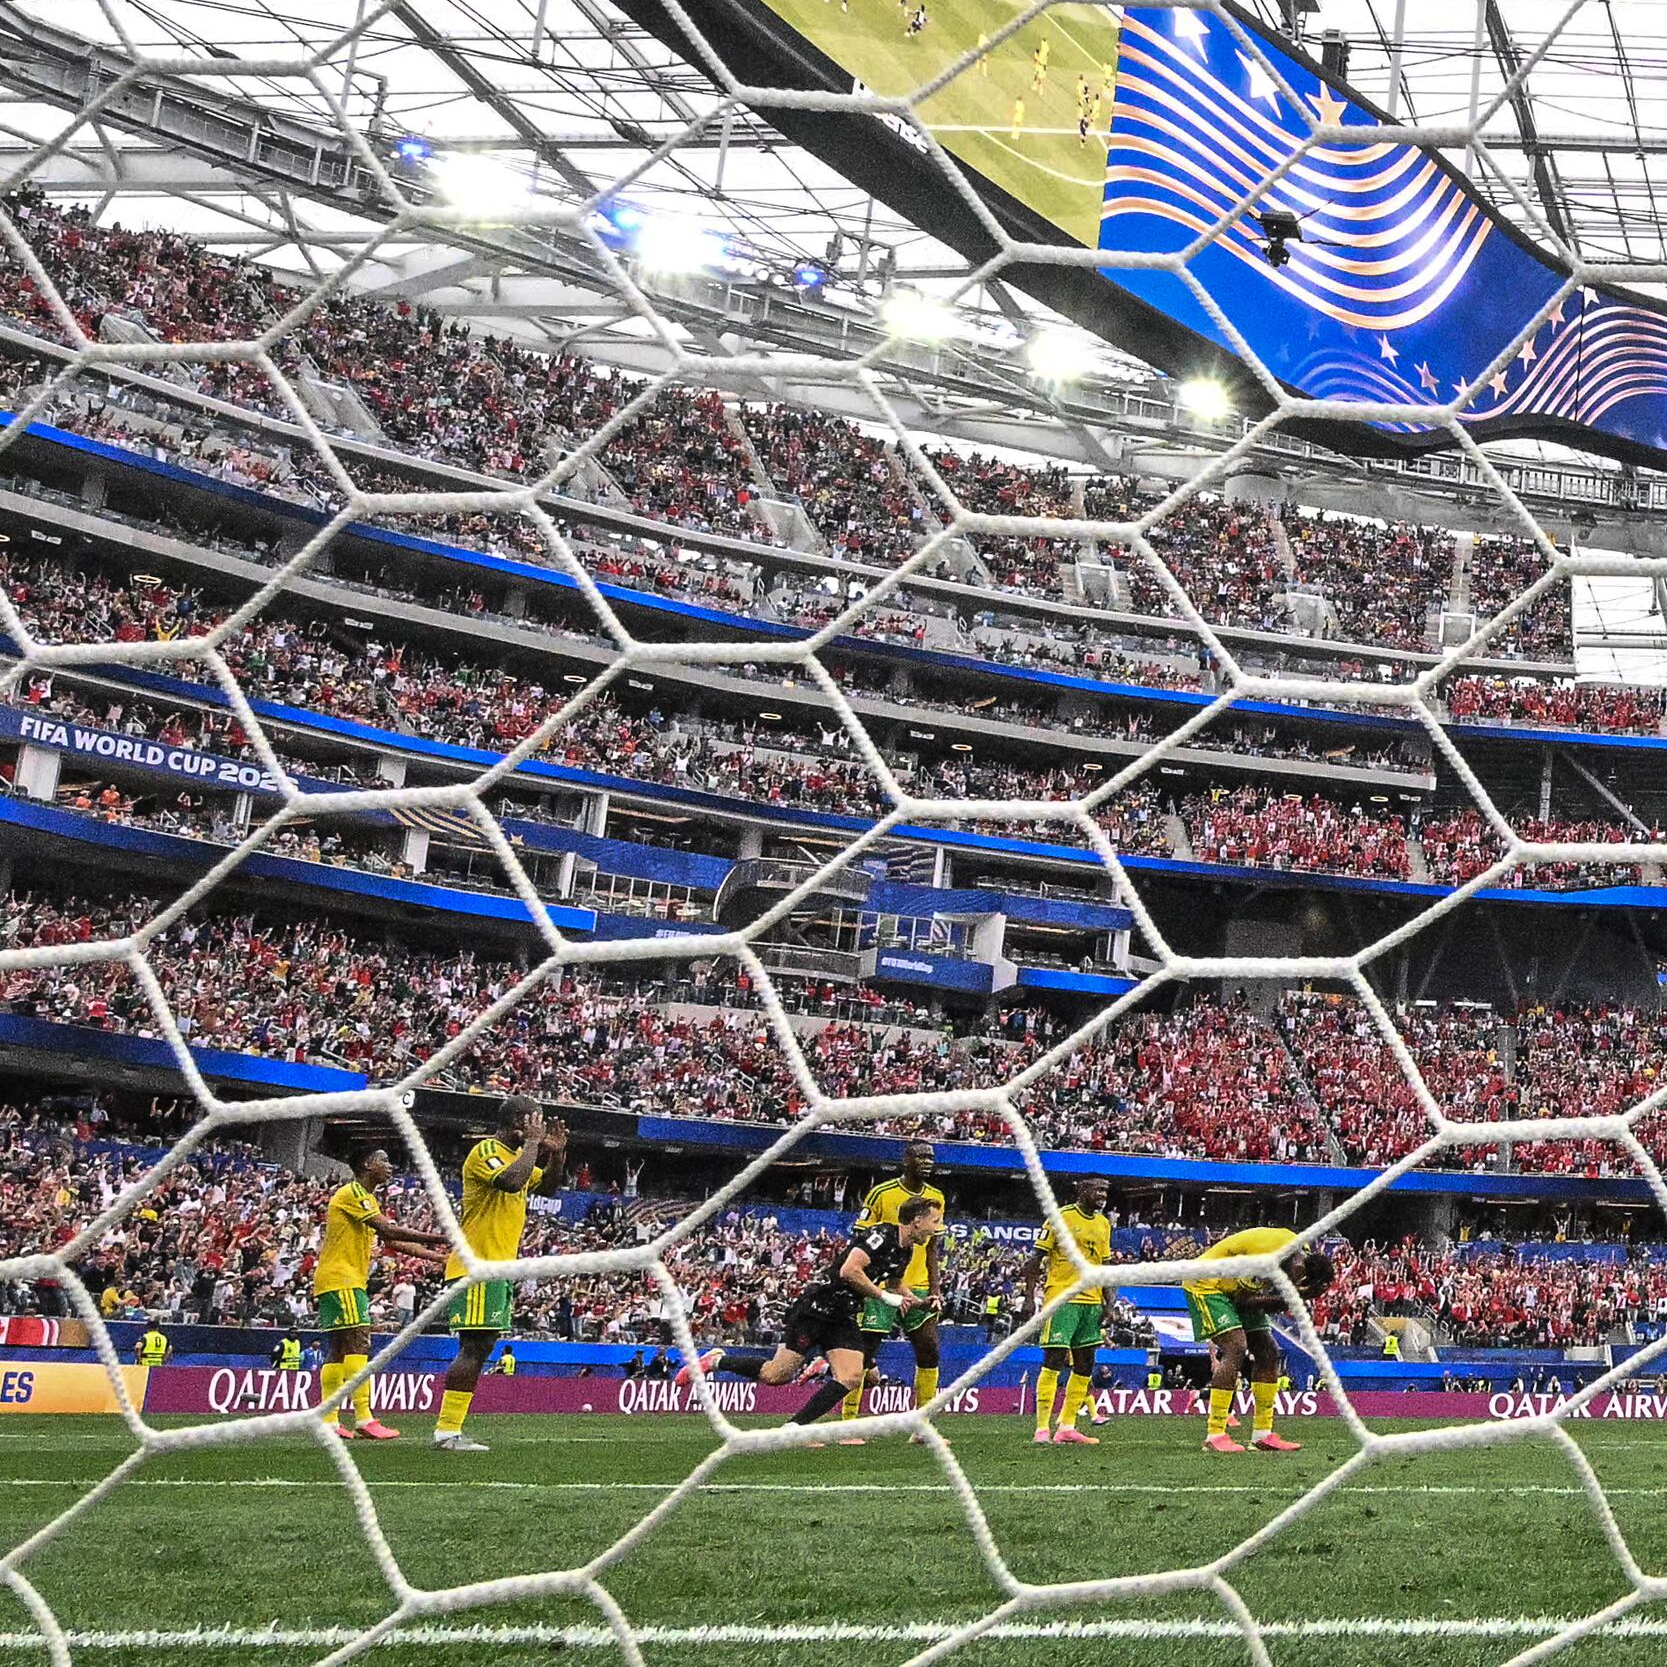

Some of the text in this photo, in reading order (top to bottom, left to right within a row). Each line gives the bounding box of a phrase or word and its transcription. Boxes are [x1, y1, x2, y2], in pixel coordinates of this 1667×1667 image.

[19, 715, 298, 792] FIFA WORLD CUP 202
[208, 1367, 312, 1414] QATAR
[618, 1379, 682, 1413] QATAR
[869, 1385, 912, 1414] QATAR
[1095, 1389, 1172, 1415] ATAR
